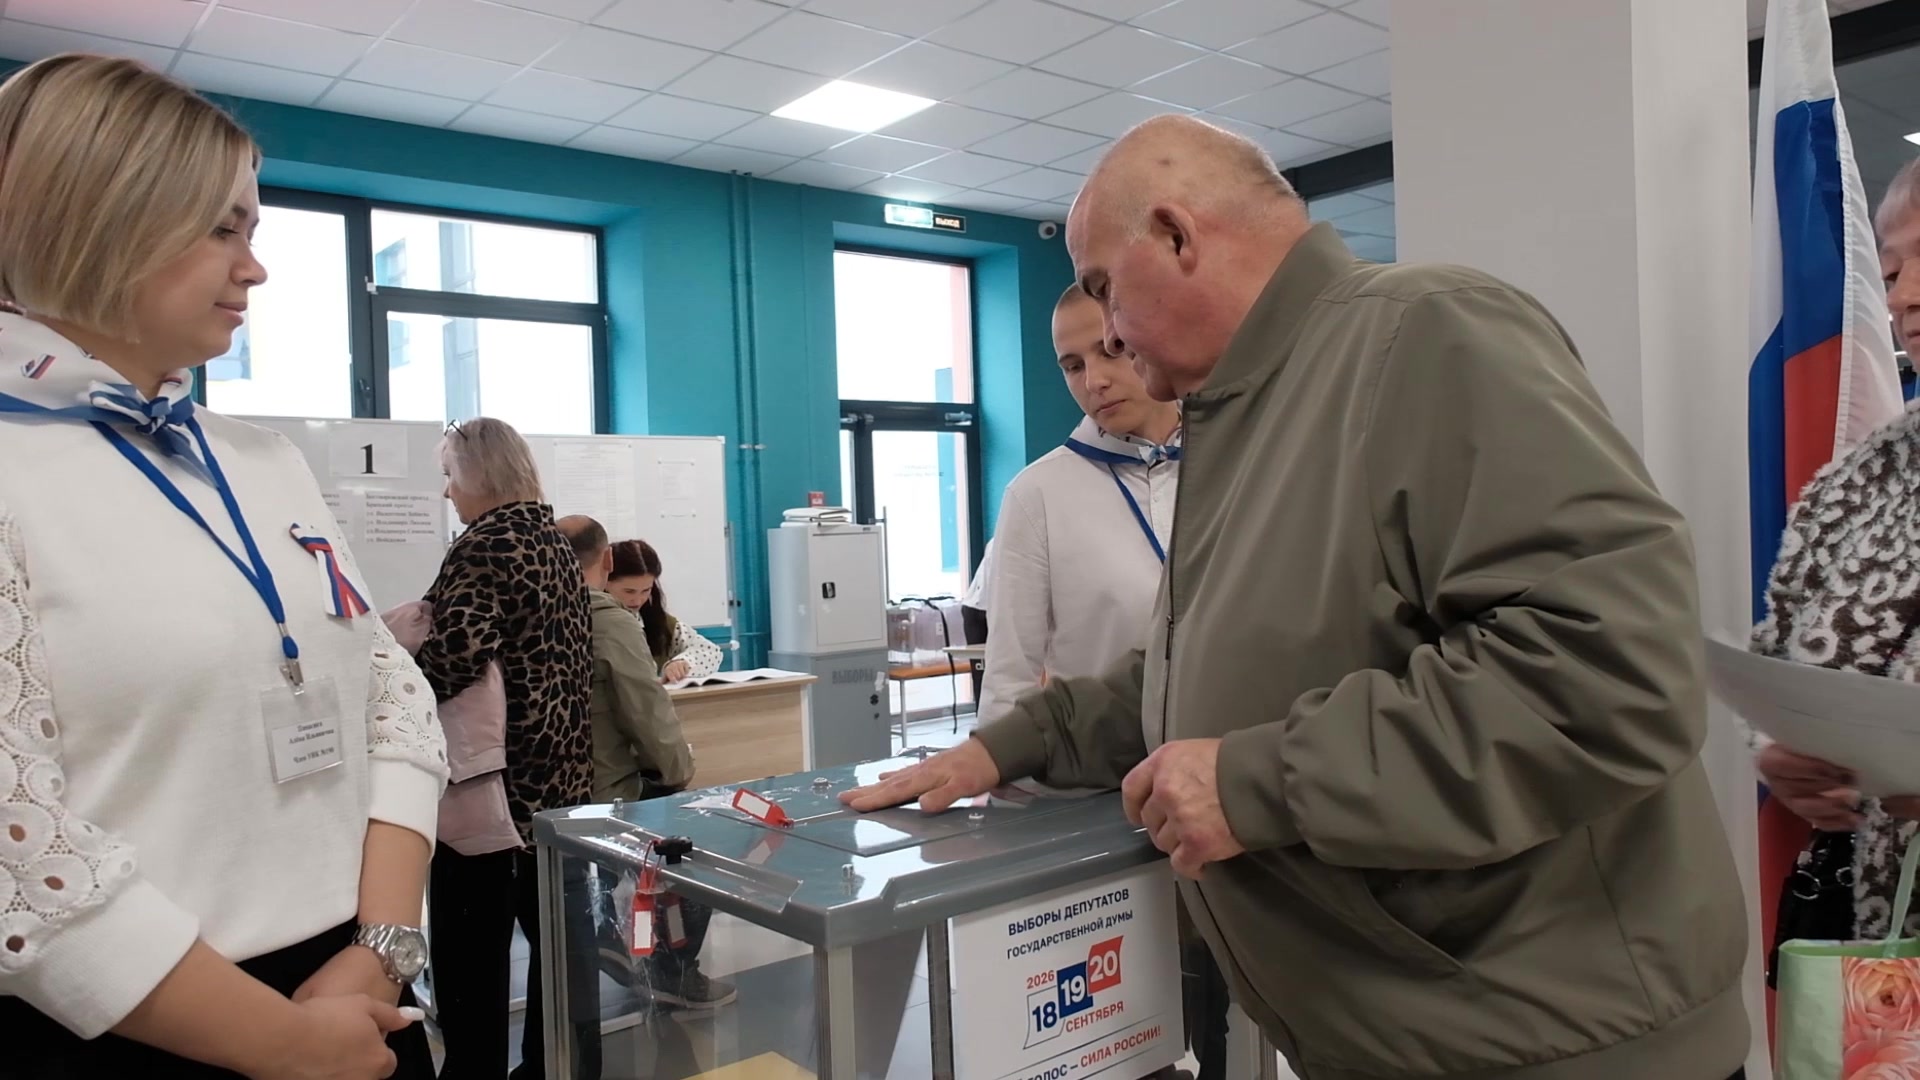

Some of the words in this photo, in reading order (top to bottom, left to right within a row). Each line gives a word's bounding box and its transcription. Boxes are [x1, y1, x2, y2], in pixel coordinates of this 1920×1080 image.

[360, 443, 378, 474] 1
[1008, 909, 1061, 936] ВЫБОРЫ
[1064, 888, 1129, 919] ДЕПУТАТОВ
[1007, 917, 1104, 959] ГОСУДАРСТВЕННОЙ
[1105, 910, 1133, 930] ДУМЫ
[1026, 970, 1055, 989] 2026
[1032, 1001, 1057, 1032] 18
[1060, 975, 1086, 1006] 19
[1089, 950, 1118, 982] 20
[1065, 1001, 1124, 1033] СЕНТЯБРЯ
[1080, 1046, 1112, 1068] СИЛА
[1114, 1025, 1161, 1054] РОССИИ!
